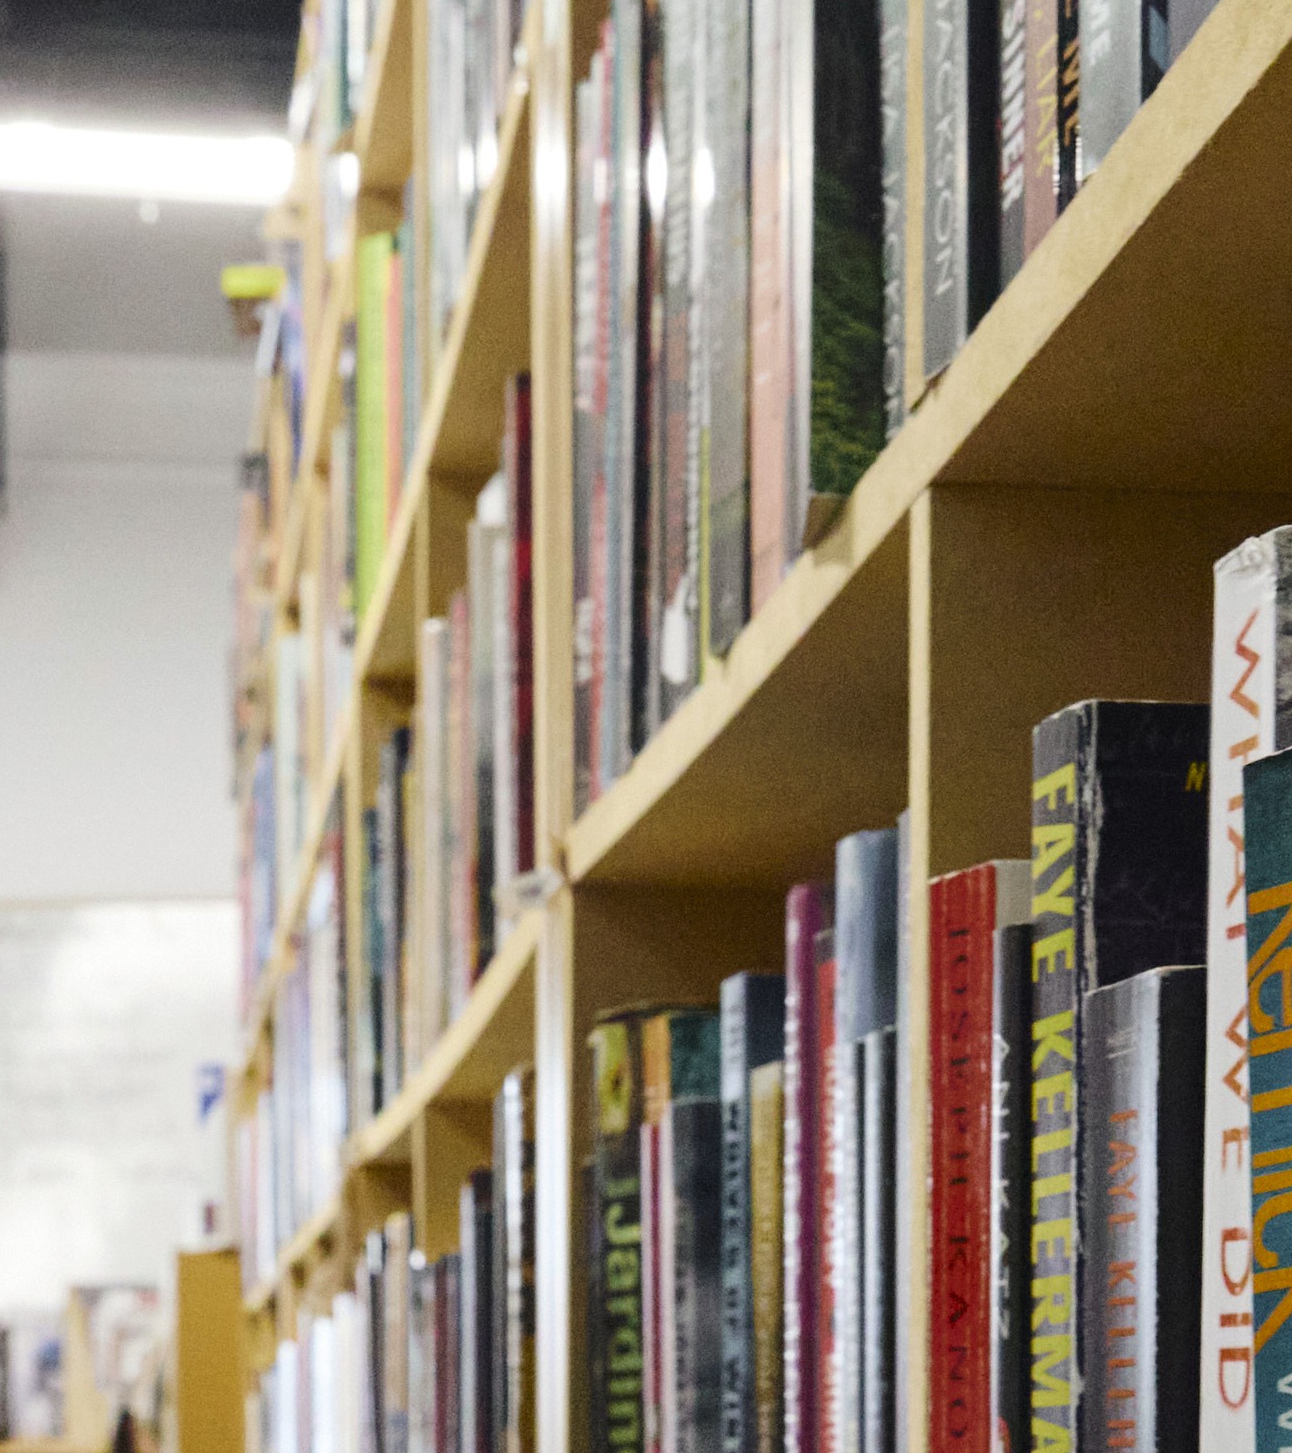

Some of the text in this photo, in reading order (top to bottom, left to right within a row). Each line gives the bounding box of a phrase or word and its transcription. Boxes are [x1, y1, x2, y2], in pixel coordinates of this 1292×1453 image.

[1030, 761, 1076, 986] FAYE
[947, 927, 969, 1187] JOSEPH
[1107, 1107, 1139, 1240] FAYE
[1218, 1226, 1254, 1412] DID
